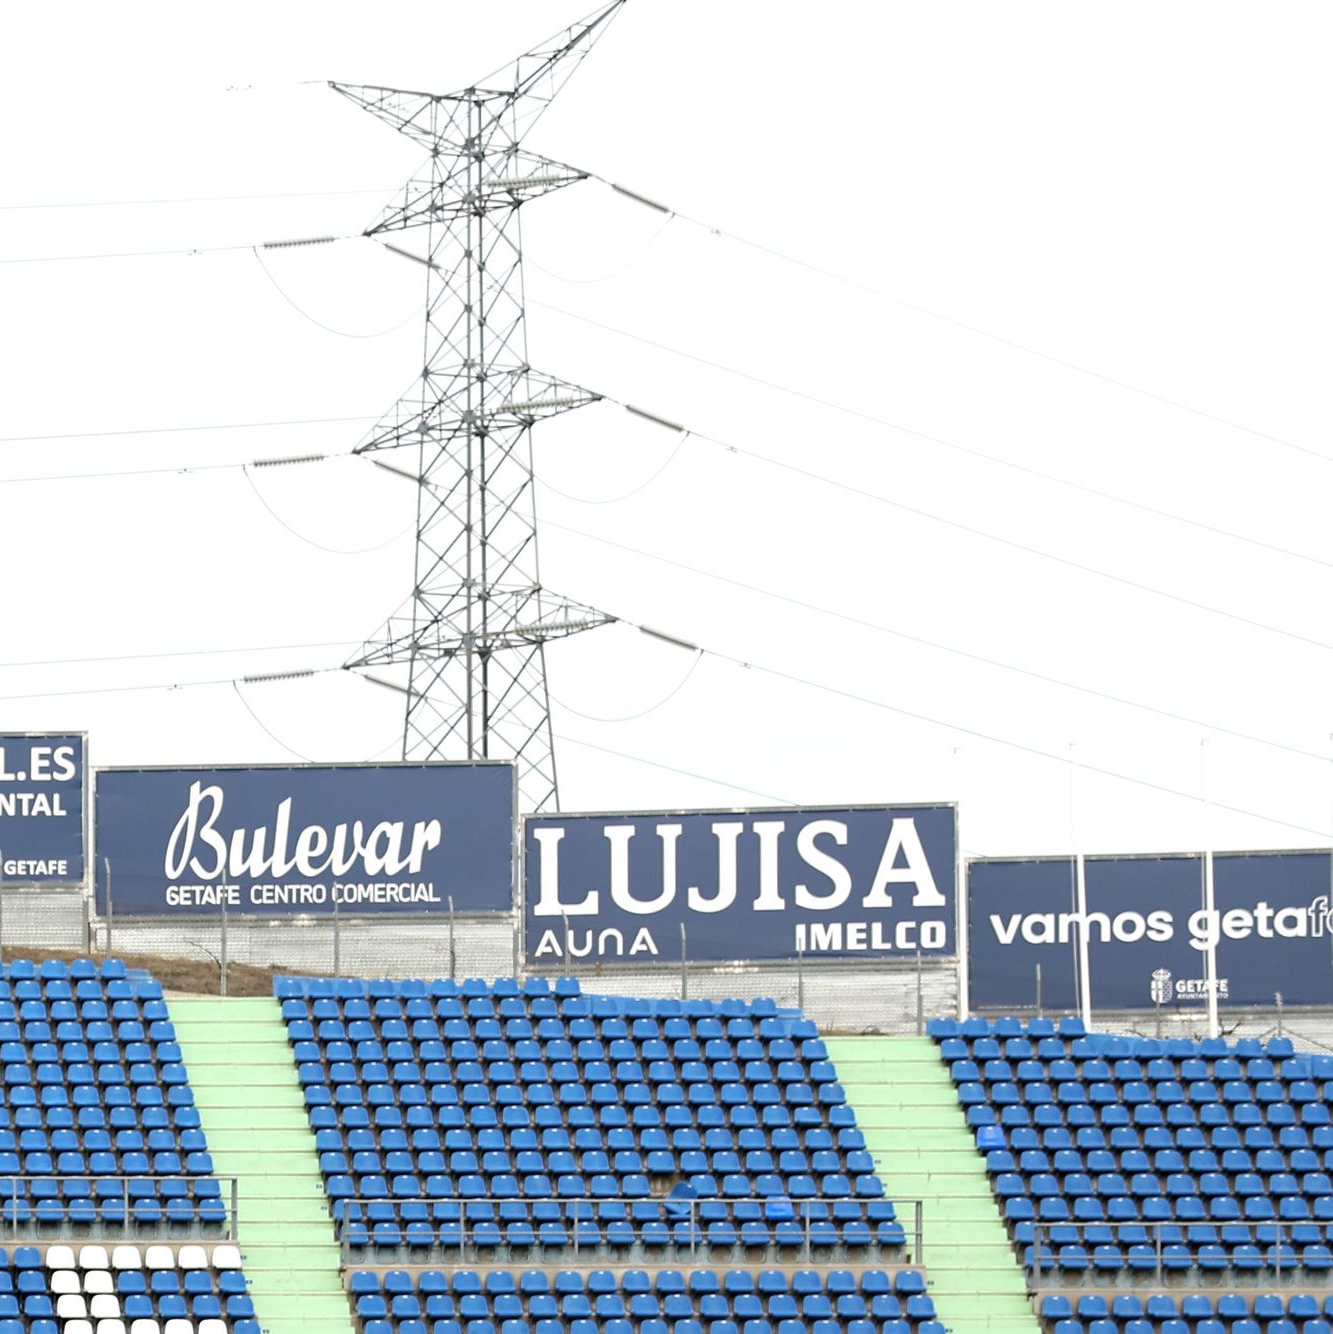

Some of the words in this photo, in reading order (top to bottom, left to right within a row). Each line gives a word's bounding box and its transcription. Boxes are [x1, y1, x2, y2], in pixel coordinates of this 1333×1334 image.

[165, 781, 441, 878] Bulevar
[3, 860, 68, 876] GETAFE
[534, 816, 946, 916] LUJISA
[165, 885, 241, 906] GETAFE
[250, 884, 327, 905] CENTRO
[332, 882, 441, 904] COMERCIAL
[795, 920, 946, 952] IMELCO
[989, 910, 1174, 945] vamos
[1188, 896, 1333, 951] getaf
